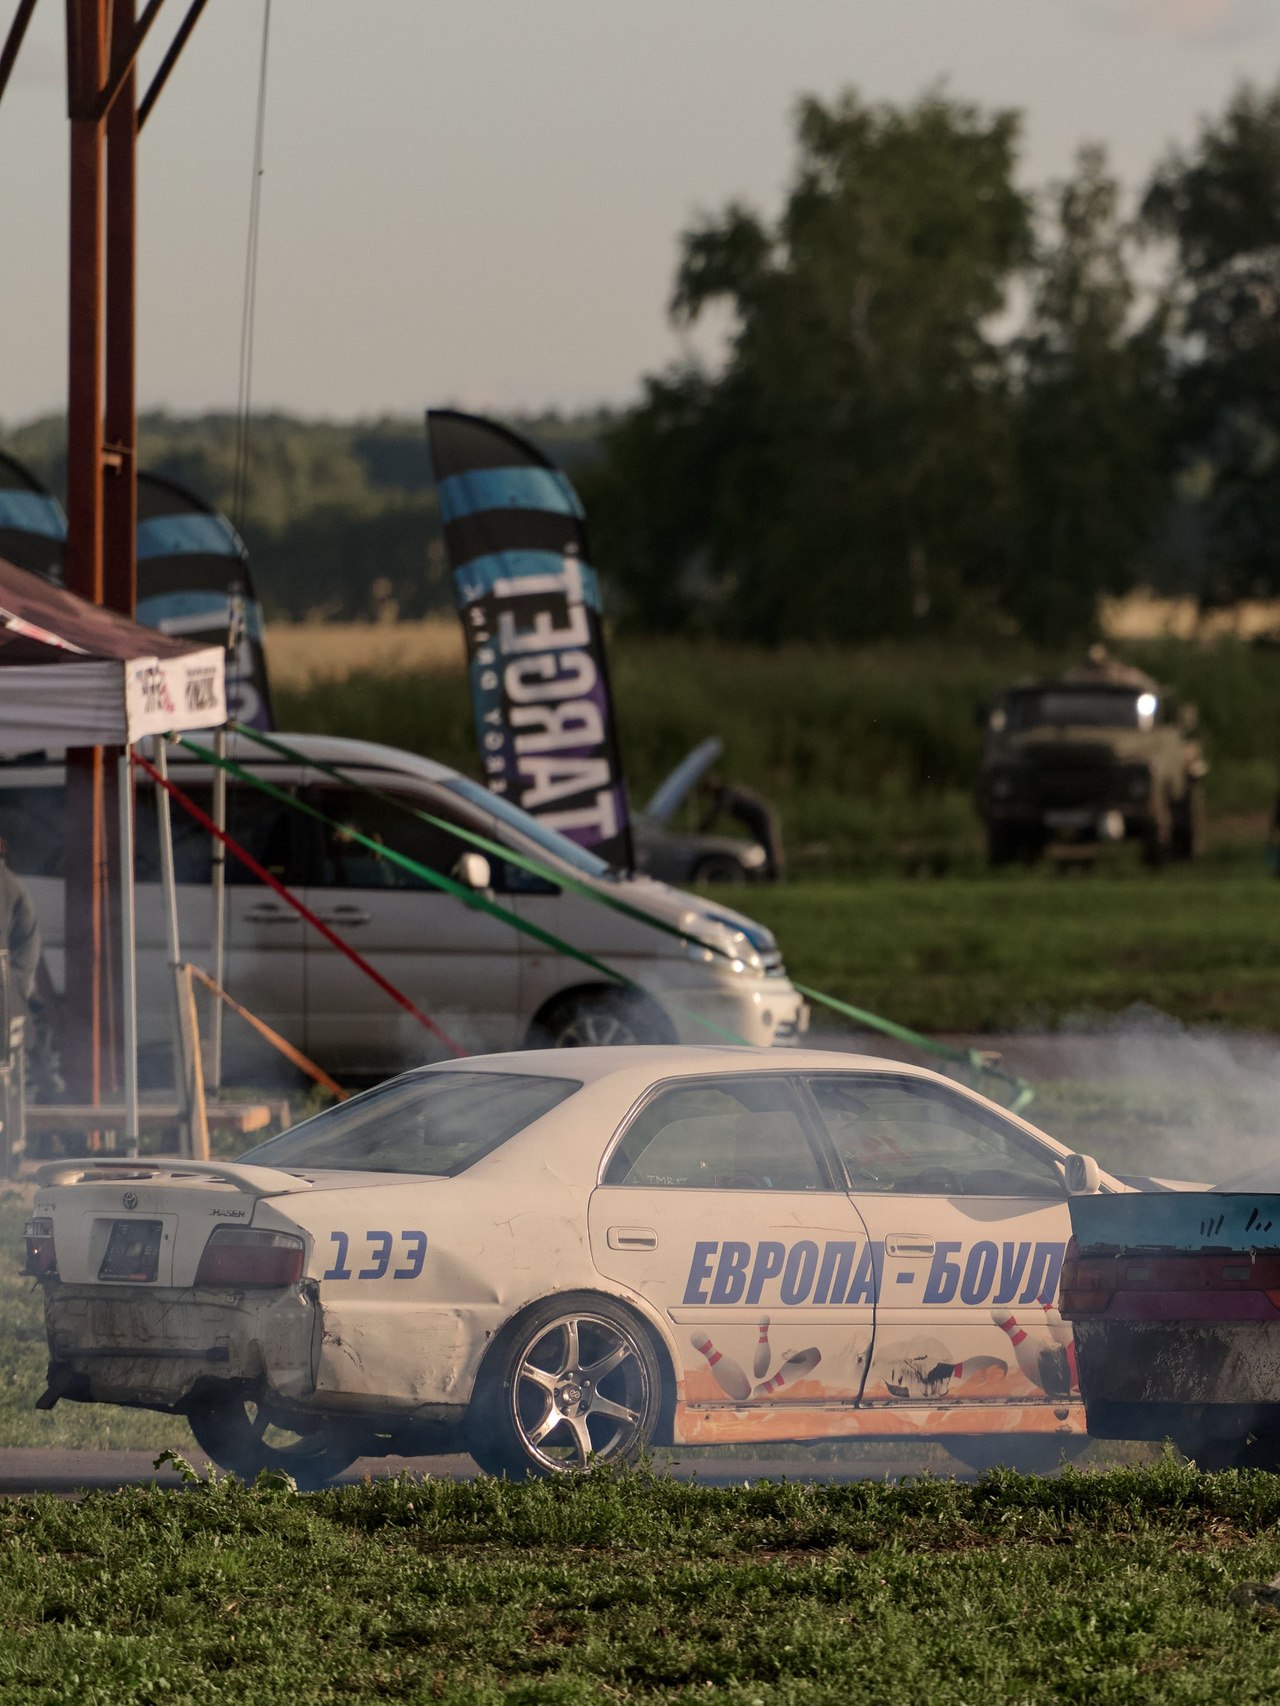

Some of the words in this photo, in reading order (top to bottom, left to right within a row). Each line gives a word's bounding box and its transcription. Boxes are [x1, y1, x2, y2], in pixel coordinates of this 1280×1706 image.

[323, 1230, 428, 1280] 133
[682, 1240, 884, 1305] ЕВРОПА
[922, 1240, 1067, 1305] БОУЛ
